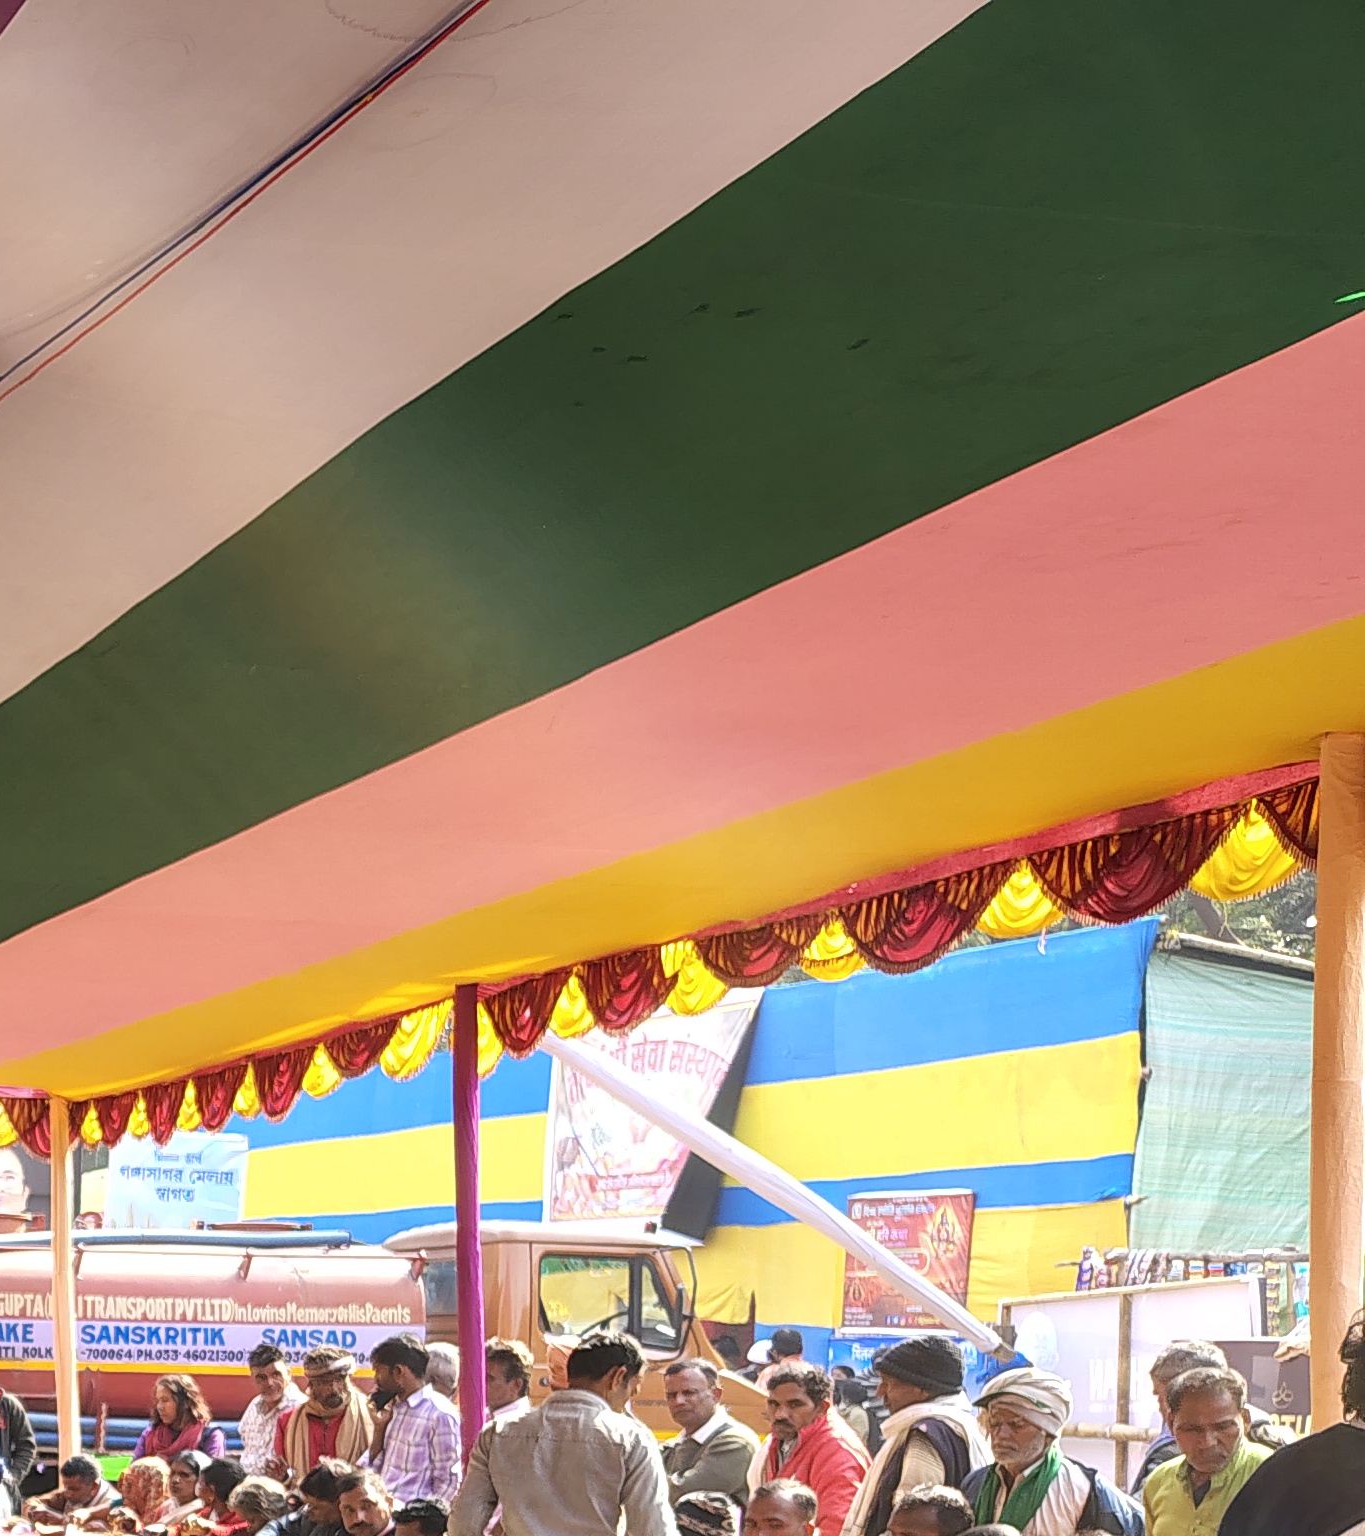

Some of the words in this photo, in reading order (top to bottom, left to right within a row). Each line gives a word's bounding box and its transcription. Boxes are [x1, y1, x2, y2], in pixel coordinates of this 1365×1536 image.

[83, 1296, 173, 1321] TRANSPORT
[80, 1324, 226, 1347] SANSKRITIK
[261, 1328, 357, 1350] SANSAD
